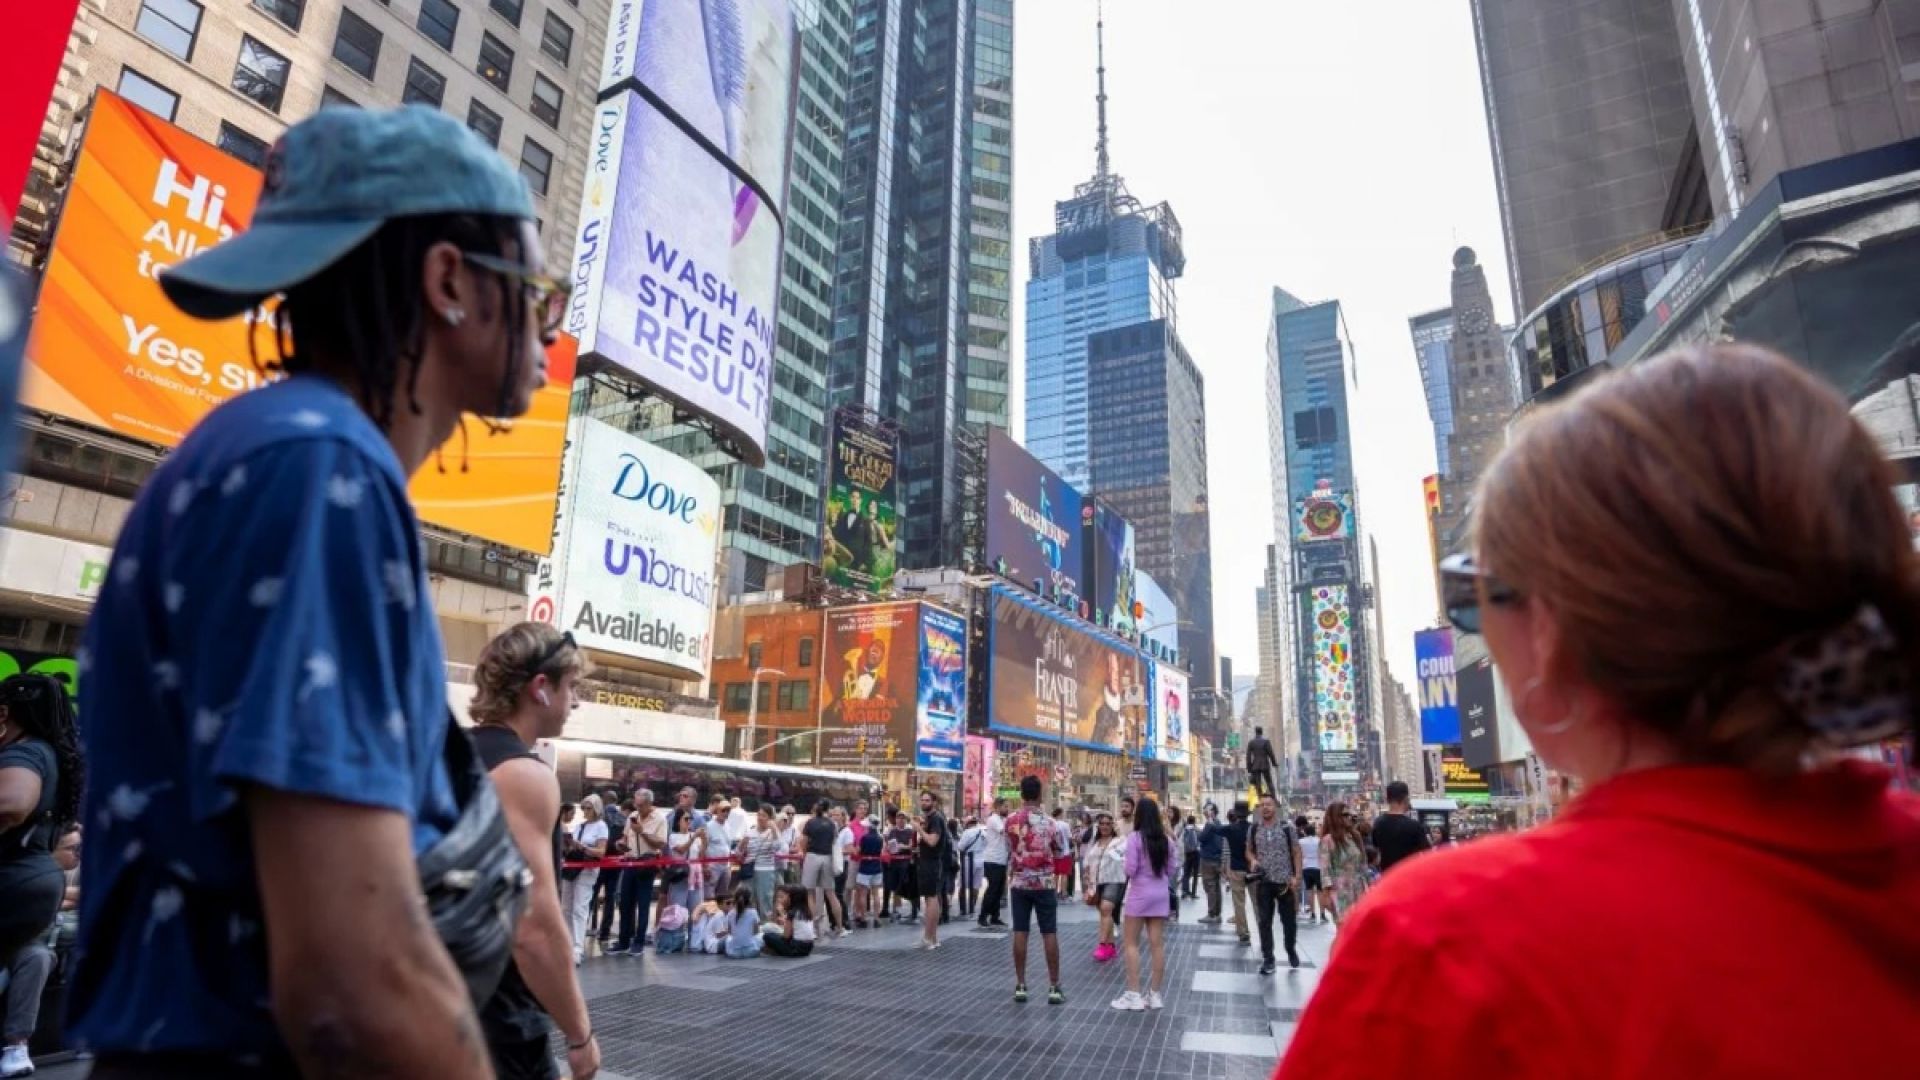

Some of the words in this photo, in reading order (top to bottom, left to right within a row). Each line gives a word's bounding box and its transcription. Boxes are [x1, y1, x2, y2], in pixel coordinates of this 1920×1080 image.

[597, 107, 622, 172] Dove
[152, 157, 233, 242] Hi,
[143, 219, 210, 258] All
[645, 229, 738, 318] WASH
[637, 273, 735, 357] STYLE
[122, 313, 213, 386] Yes,
[612, 452, 697, 524] Dove
[539, 562, 552, 591] at
[604, 537, 711, 610] unbrush
[573, 599, 686, 654] Available
[596, 690, 665, 712] EXPRESS
[842, 709, 891, 723] WORLD
